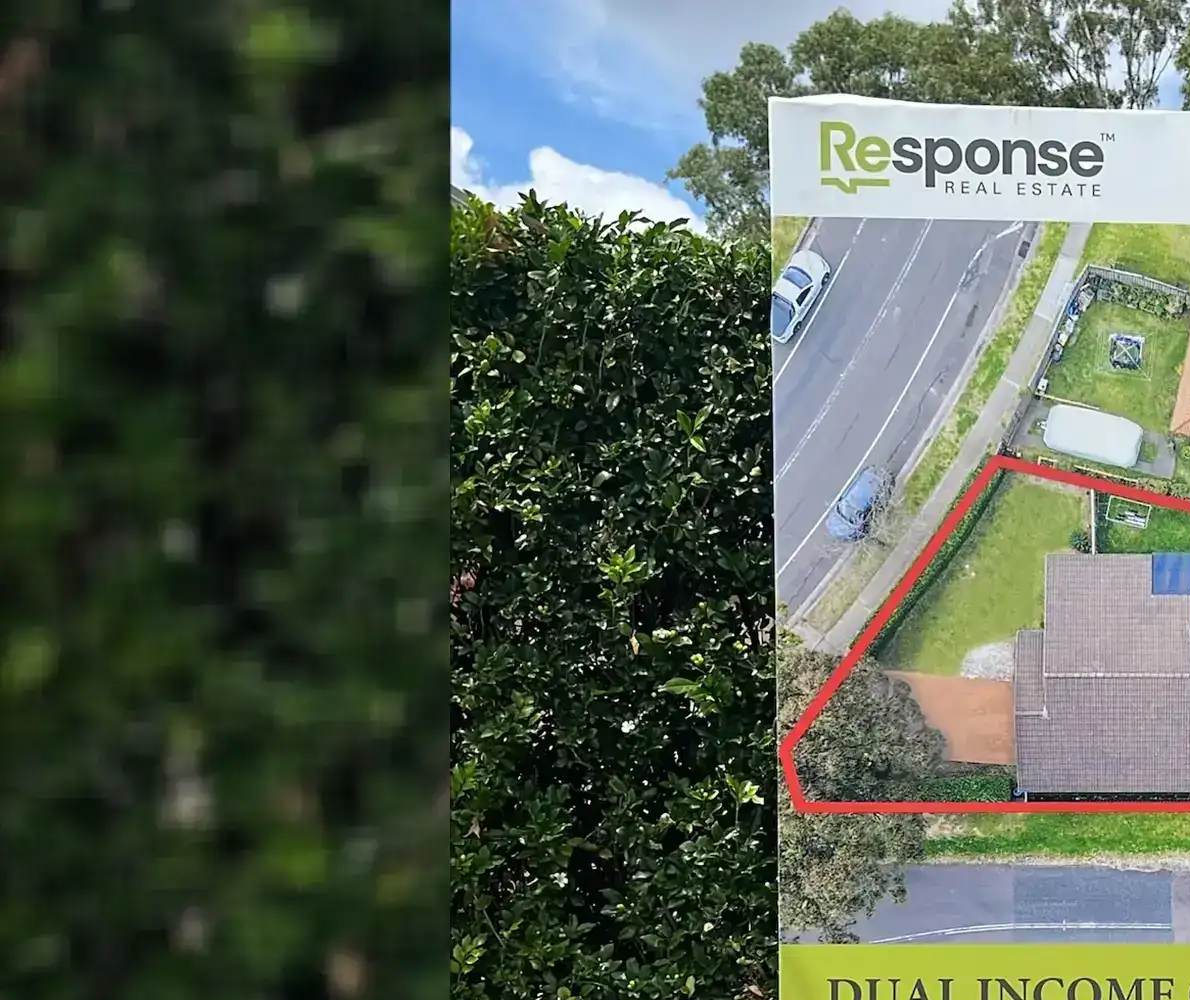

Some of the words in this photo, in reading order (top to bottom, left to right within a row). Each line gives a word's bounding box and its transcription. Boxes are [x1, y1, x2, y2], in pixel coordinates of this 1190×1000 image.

[820, 121, 1104, 187] Response
[945, 181, 1001, 195] REAL
[1017, 182, 1101, 197] ESTATE
